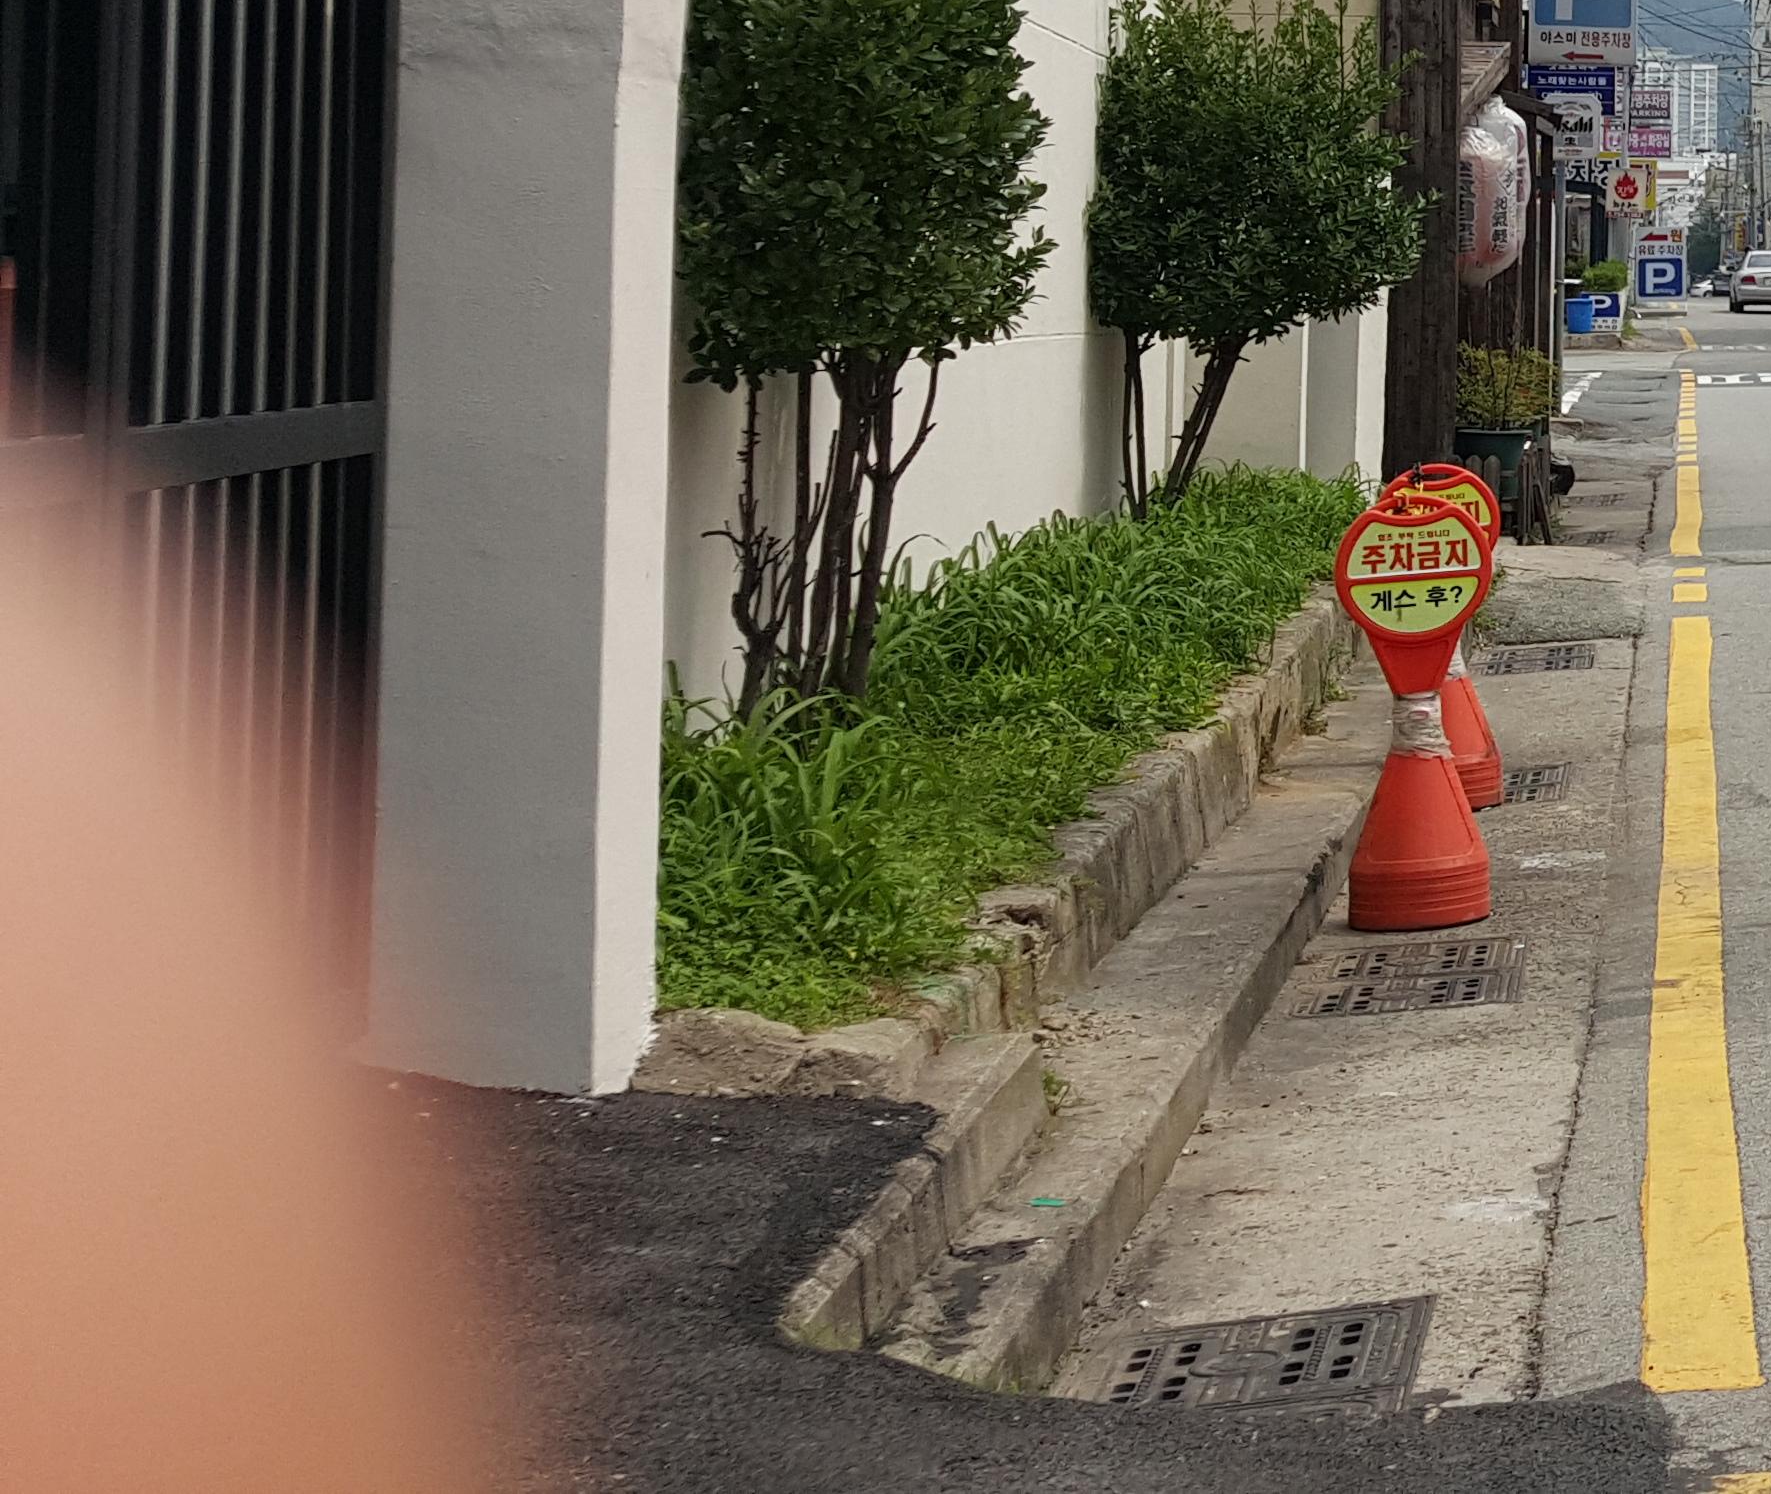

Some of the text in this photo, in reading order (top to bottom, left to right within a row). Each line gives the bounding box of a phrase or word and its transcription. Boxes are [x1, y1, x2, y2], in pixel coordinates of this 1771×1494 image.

[1539, 31, 1632, 49] 야스미 전용주차장
[1658, 244, 1684, 256] 주차장
[1361, 538, 1469, 575] 주차금지
[1370, 585, 1463, 612] 게스 후?
